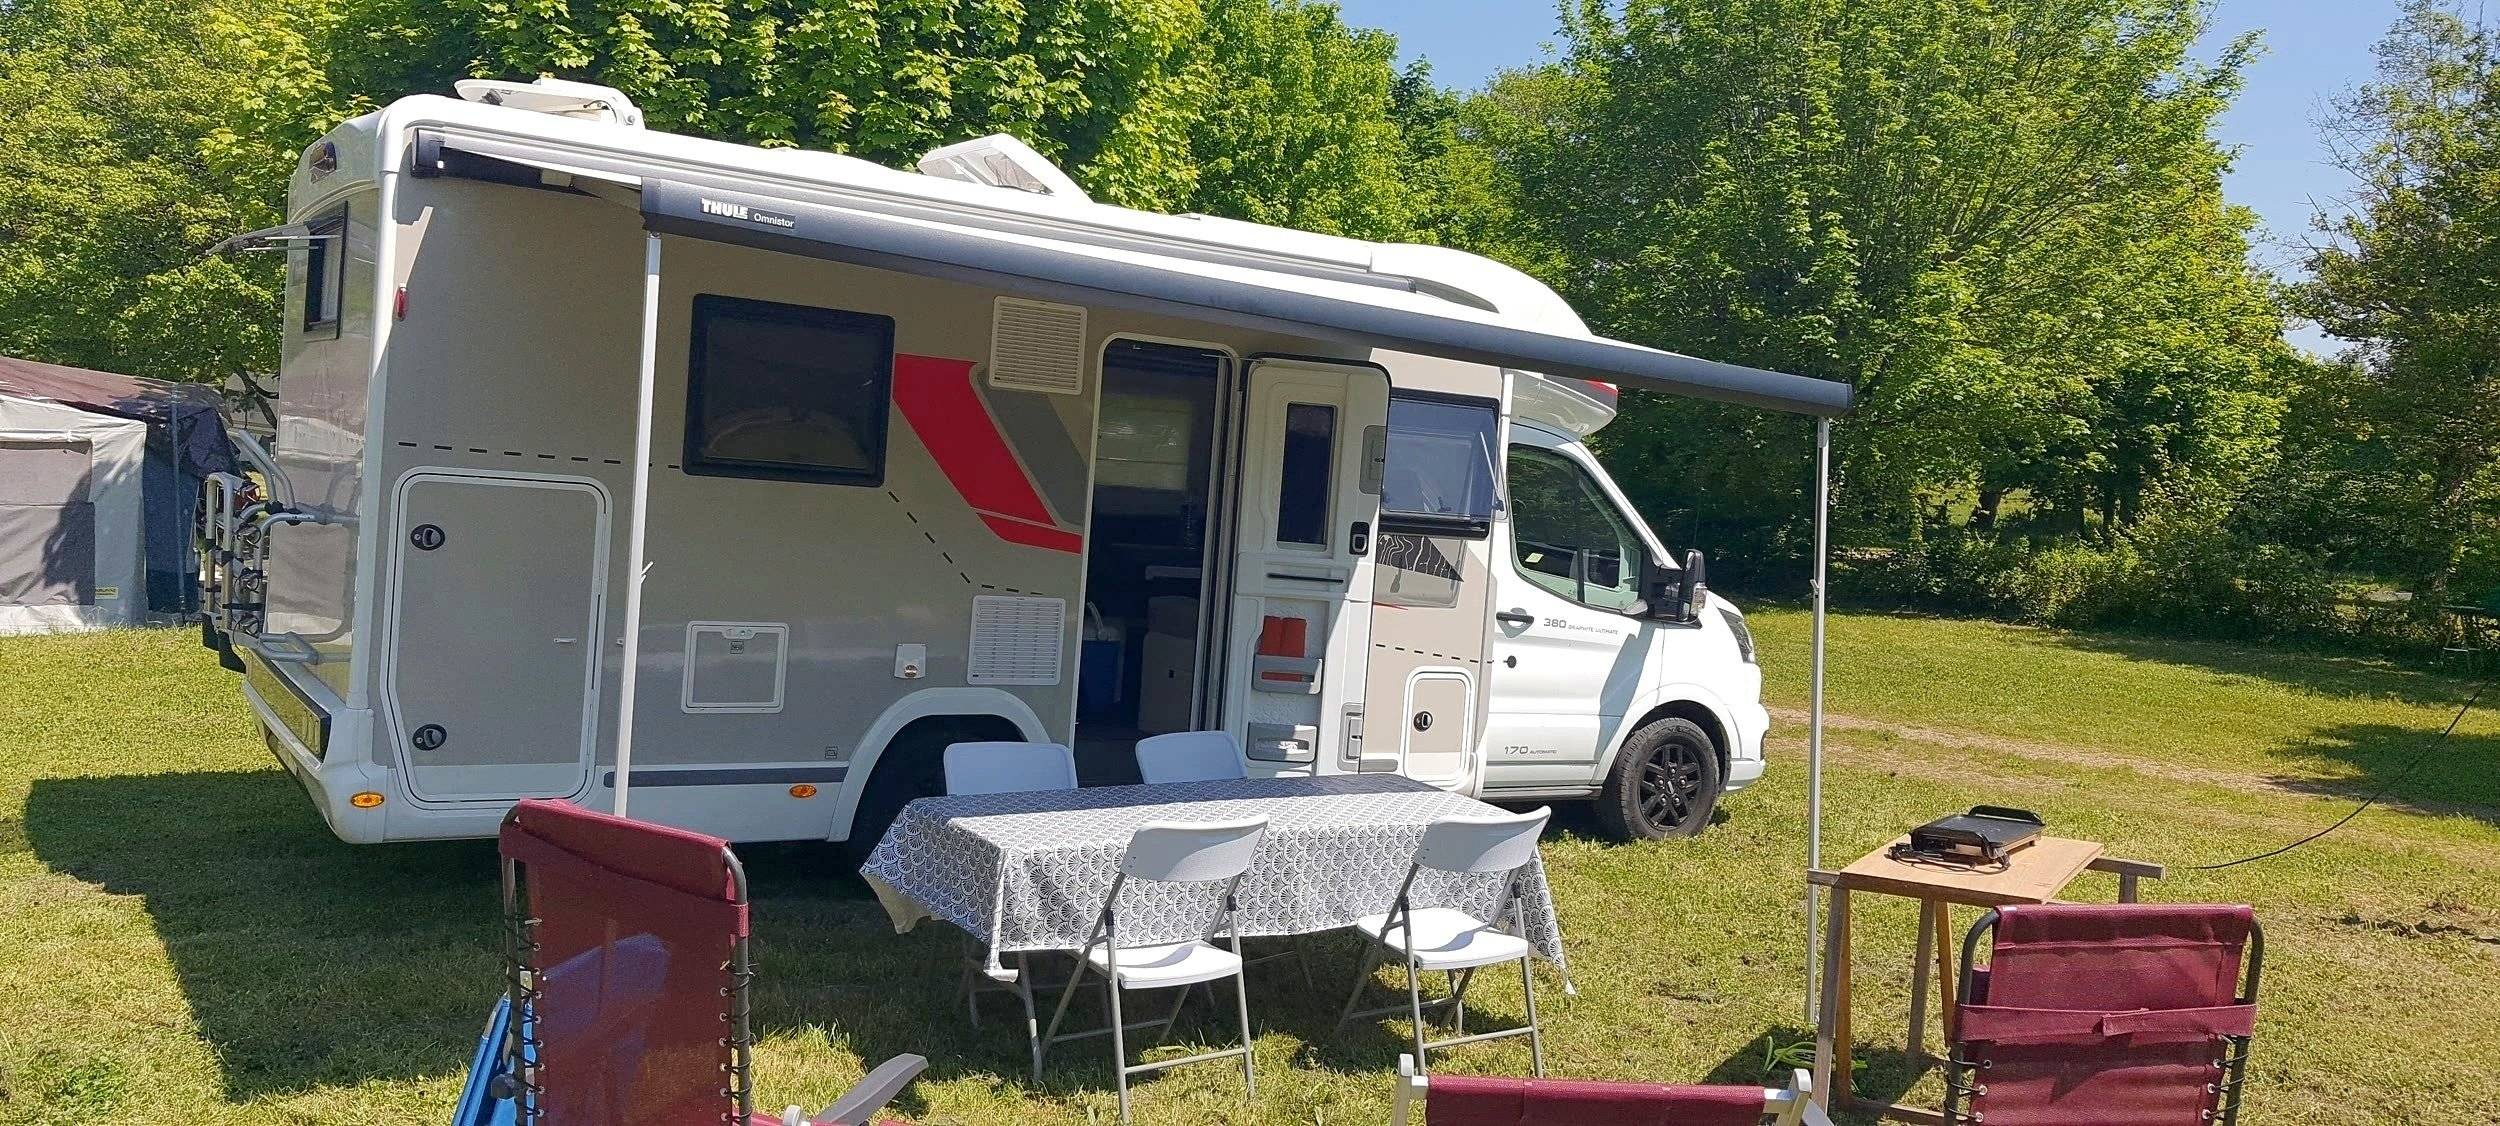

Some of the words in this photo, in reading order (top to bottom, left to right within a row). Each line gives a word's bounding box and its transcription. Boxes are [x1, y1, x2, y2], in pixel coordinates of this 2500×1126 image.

[701, 198, 748, 220] THULE
[754, 212, 795, 228] Omnistor
[1543, 618, 1567, 629] 380
[1504, 745, 1529, 755] 170
